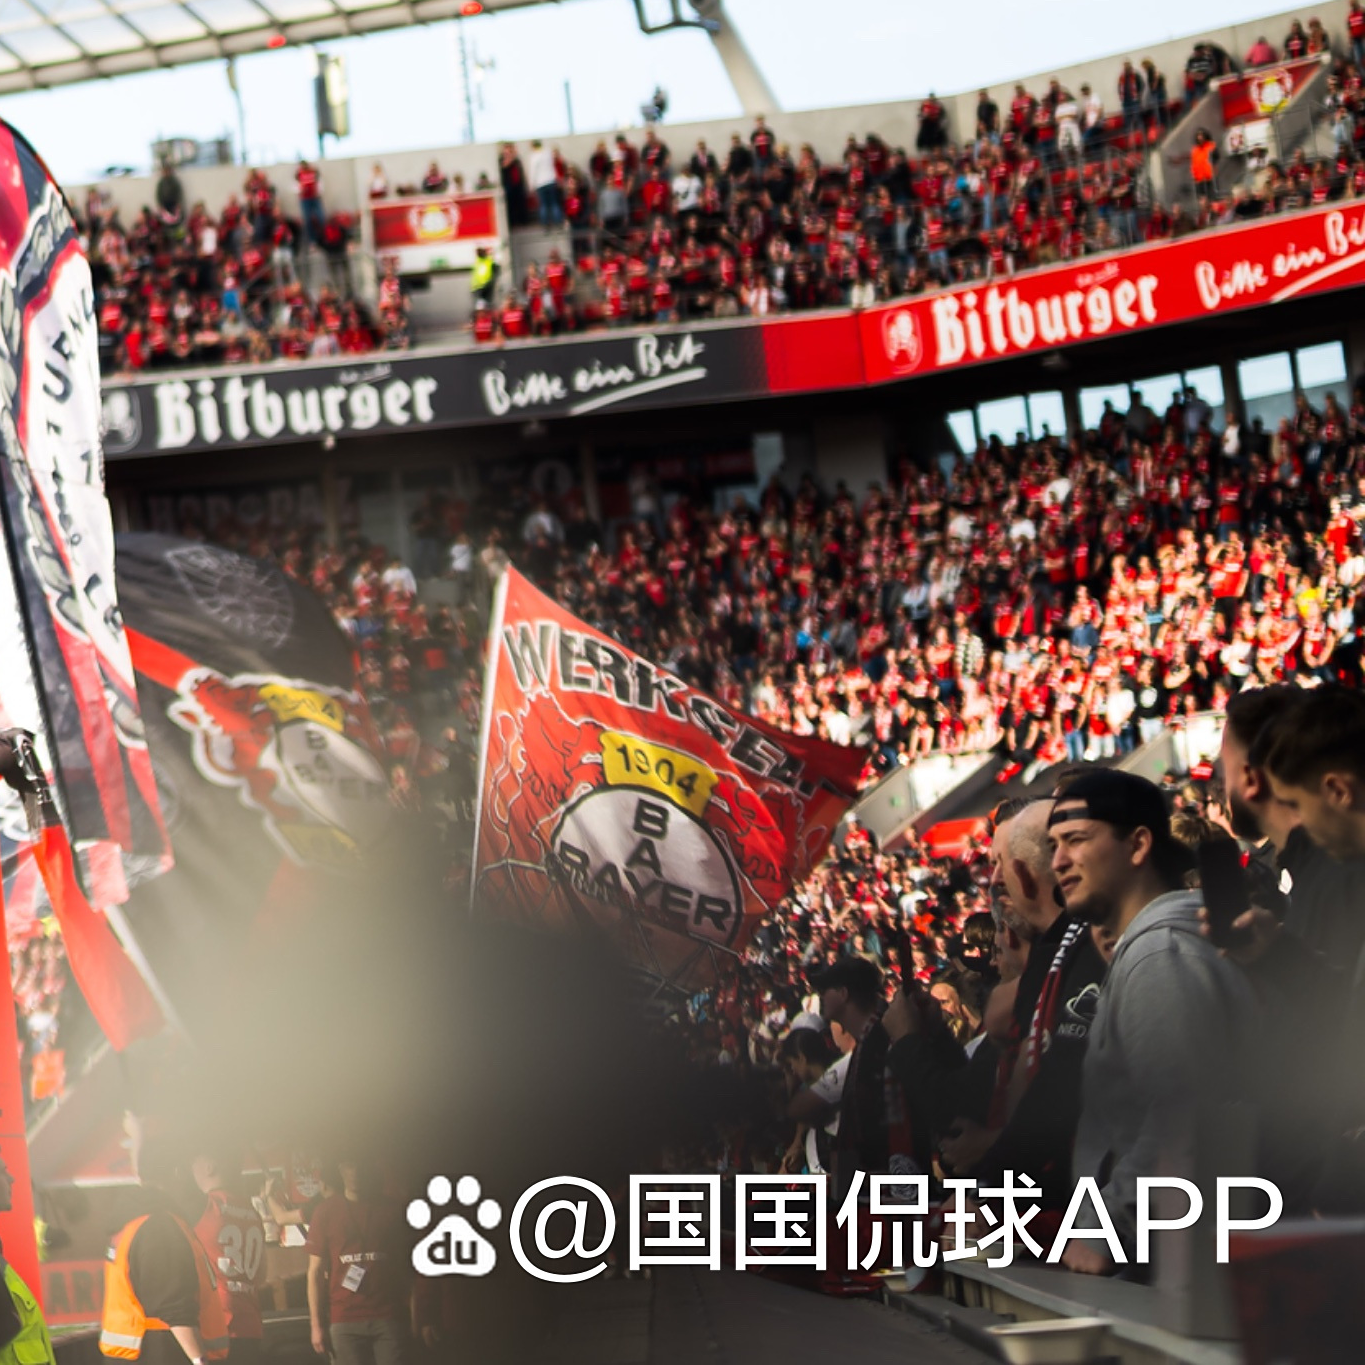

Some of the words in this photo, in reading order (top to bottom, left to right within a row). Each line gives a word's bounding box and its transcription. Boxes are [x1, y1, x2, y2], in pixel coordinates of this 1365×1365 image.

[931, 274, 1159, 366] Bitburger
[1195, 260, 1269, 311] Bitte
[1272, 243, 1326, 278] ein
[1325, 210, 1365, 257] Bi
[154, 376, 438, 449] Bitburger
[481, 368, 567, 416] Bitte
[573, 358, 635, 394] ein
[635, 333, 706, 373] Bit
[616, 742, 699, 797] 1904
